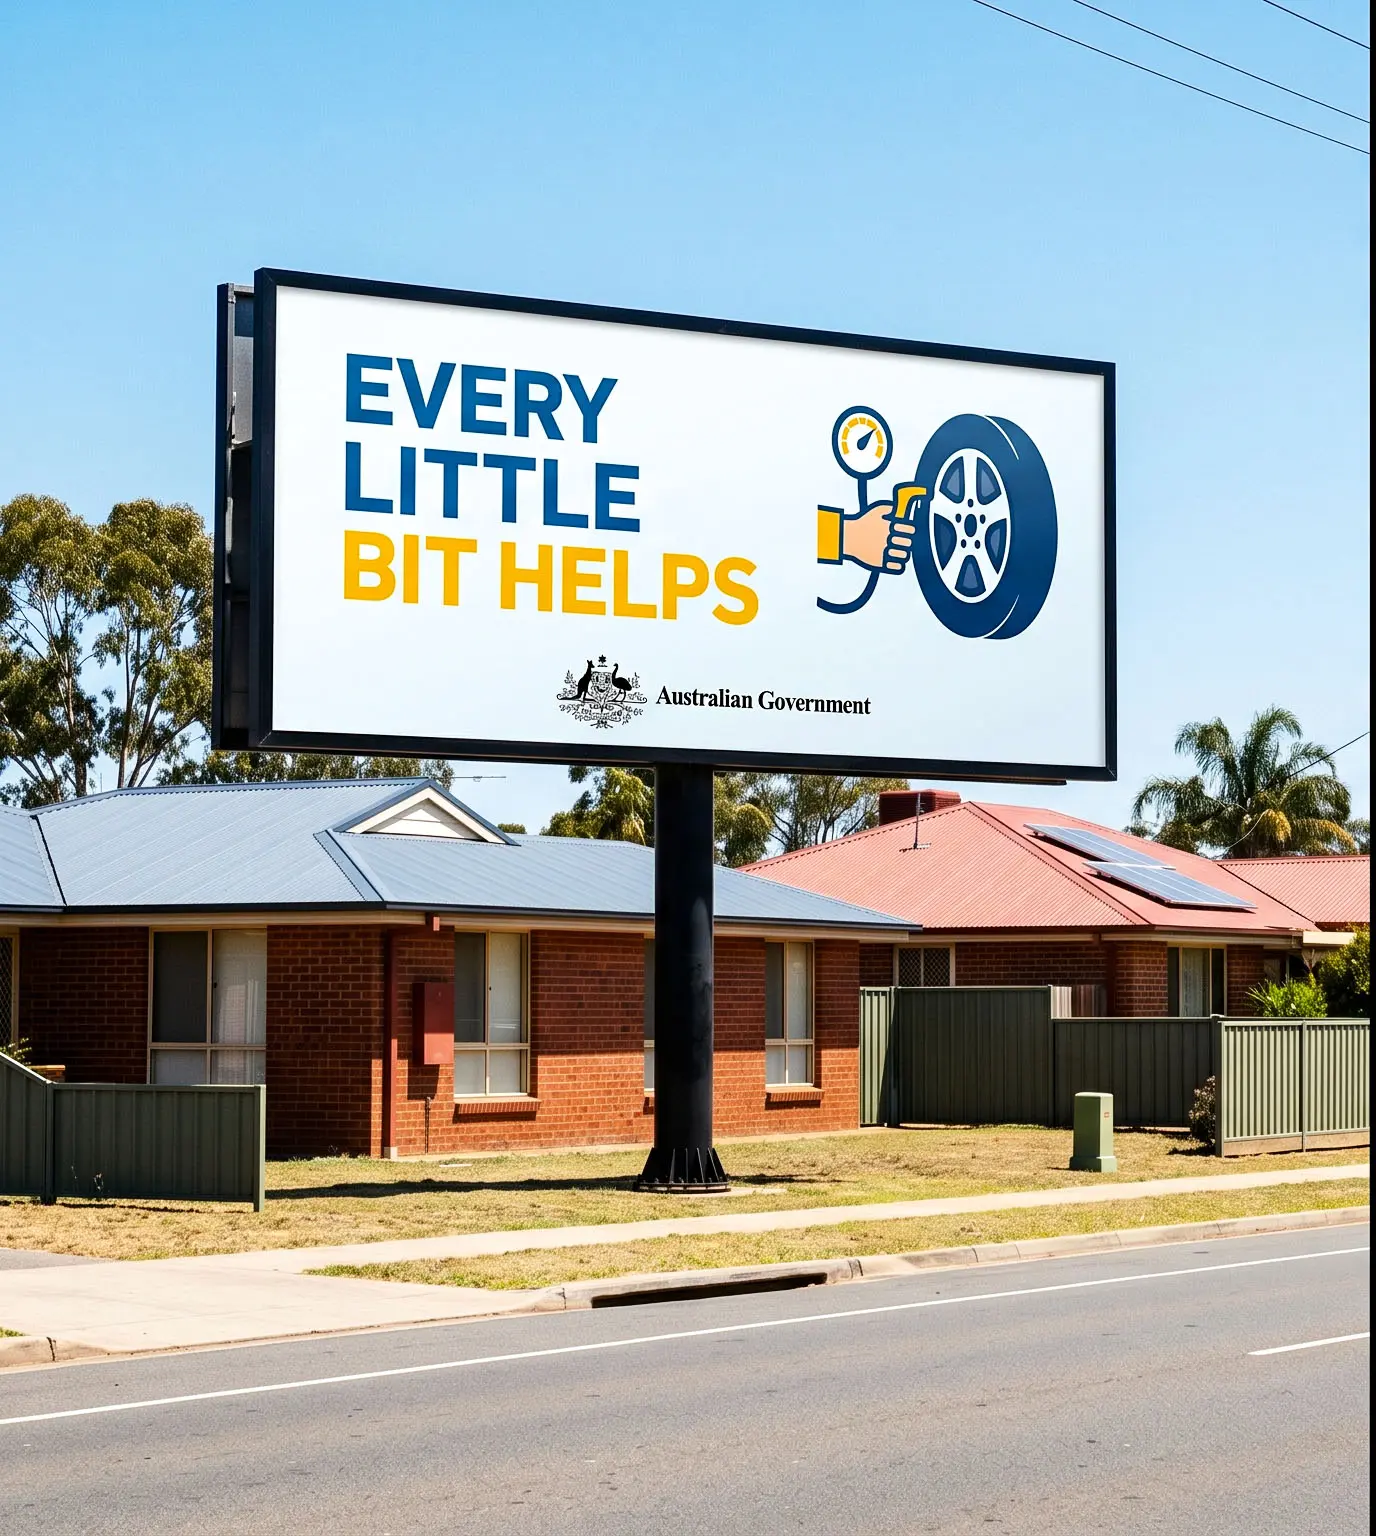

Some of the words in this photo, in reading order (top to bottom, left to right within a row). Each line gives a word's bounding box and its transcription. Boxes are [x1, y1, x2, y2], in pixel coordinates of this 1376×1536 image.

[346, 353, 618, 444] EVERY
[345, 441, 641, 533] LITTLE
[343, 530, 478, 607] BIT
[500, 542, 760, 627] HELPS
[656, 685, 753, 710] Australian
[758, 690, 872, 716] Government
